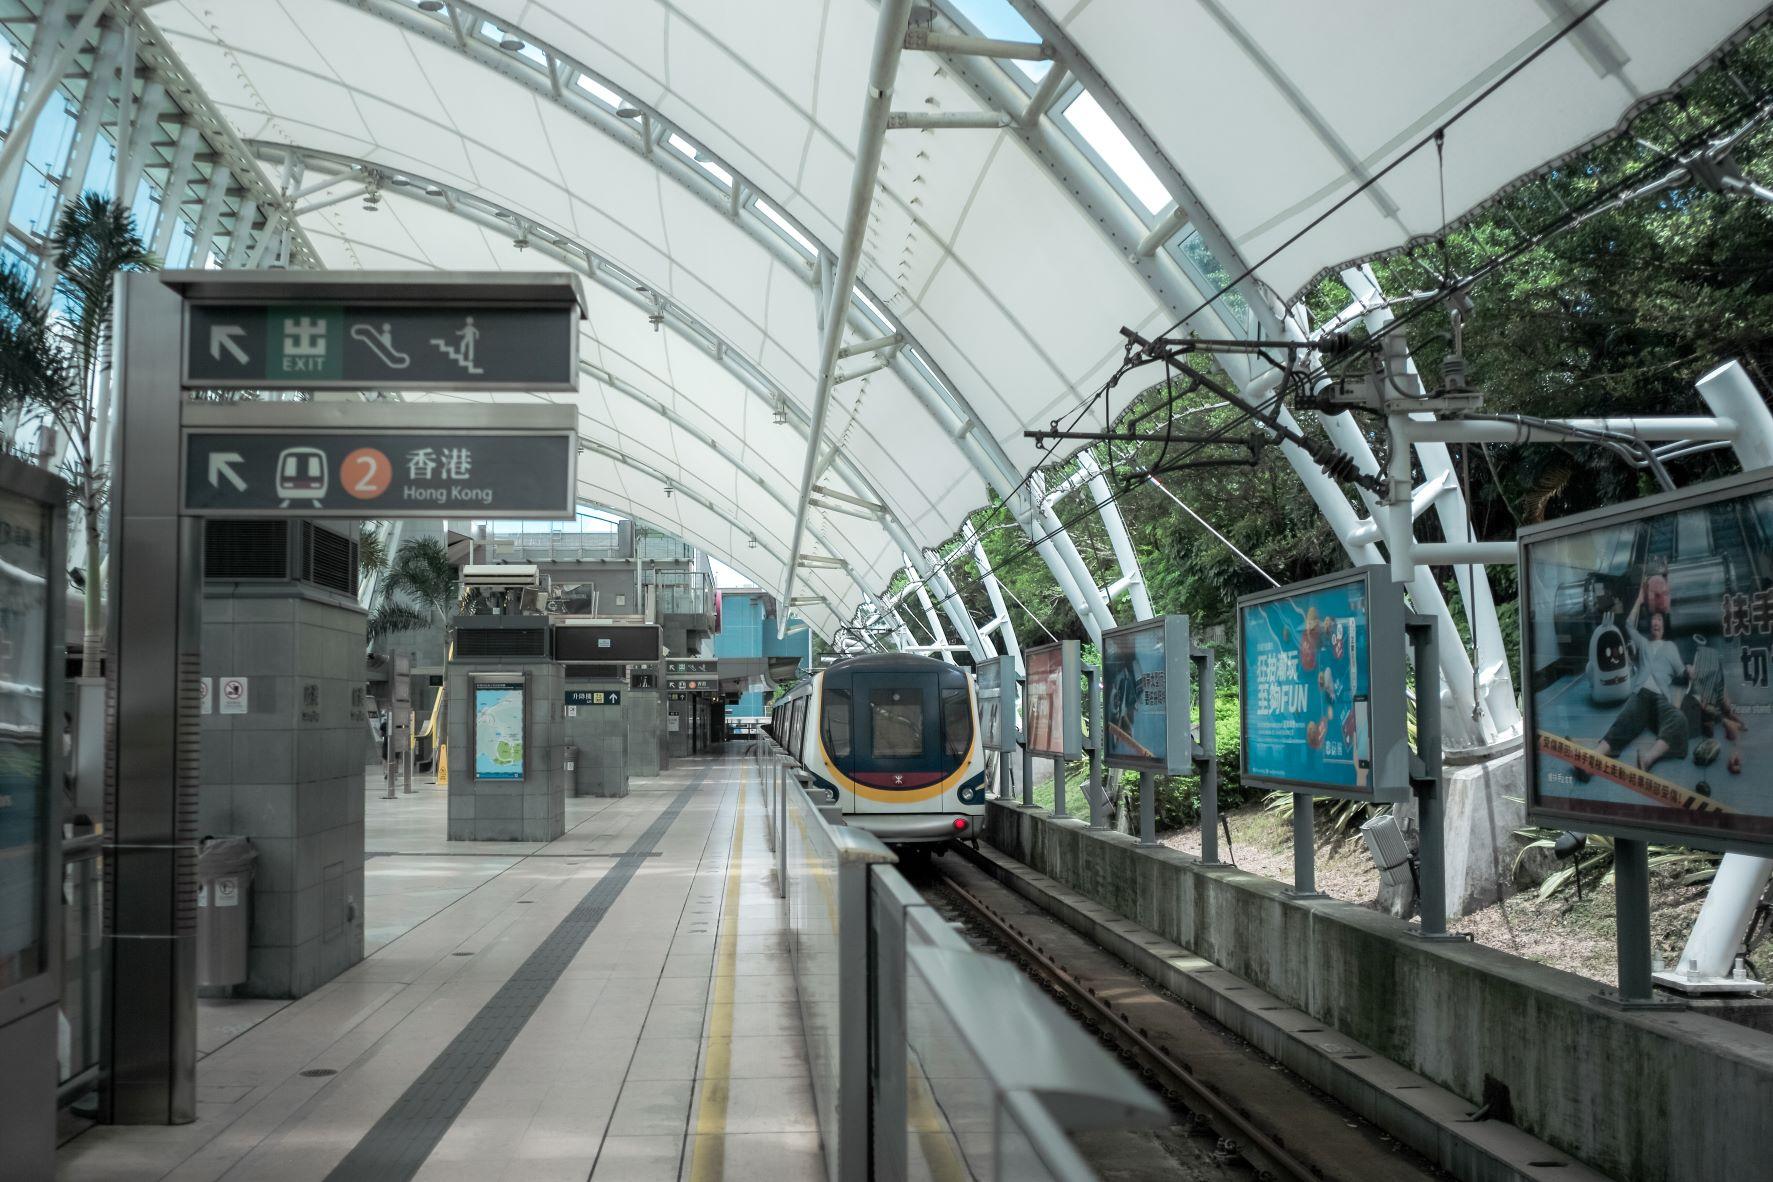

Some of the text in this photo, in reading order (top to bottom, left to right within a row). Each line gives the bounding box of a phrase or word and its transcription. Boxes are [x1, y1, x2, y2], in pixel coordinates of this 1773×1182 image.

[283, 316, 327, 355] 出
[283, 357, 326, 371] EXIT
[356, 448, 473, 492] 2 香港
[403, 485, 493, 504] Hong Kong
[1740, 645, 1773, 688] 切
